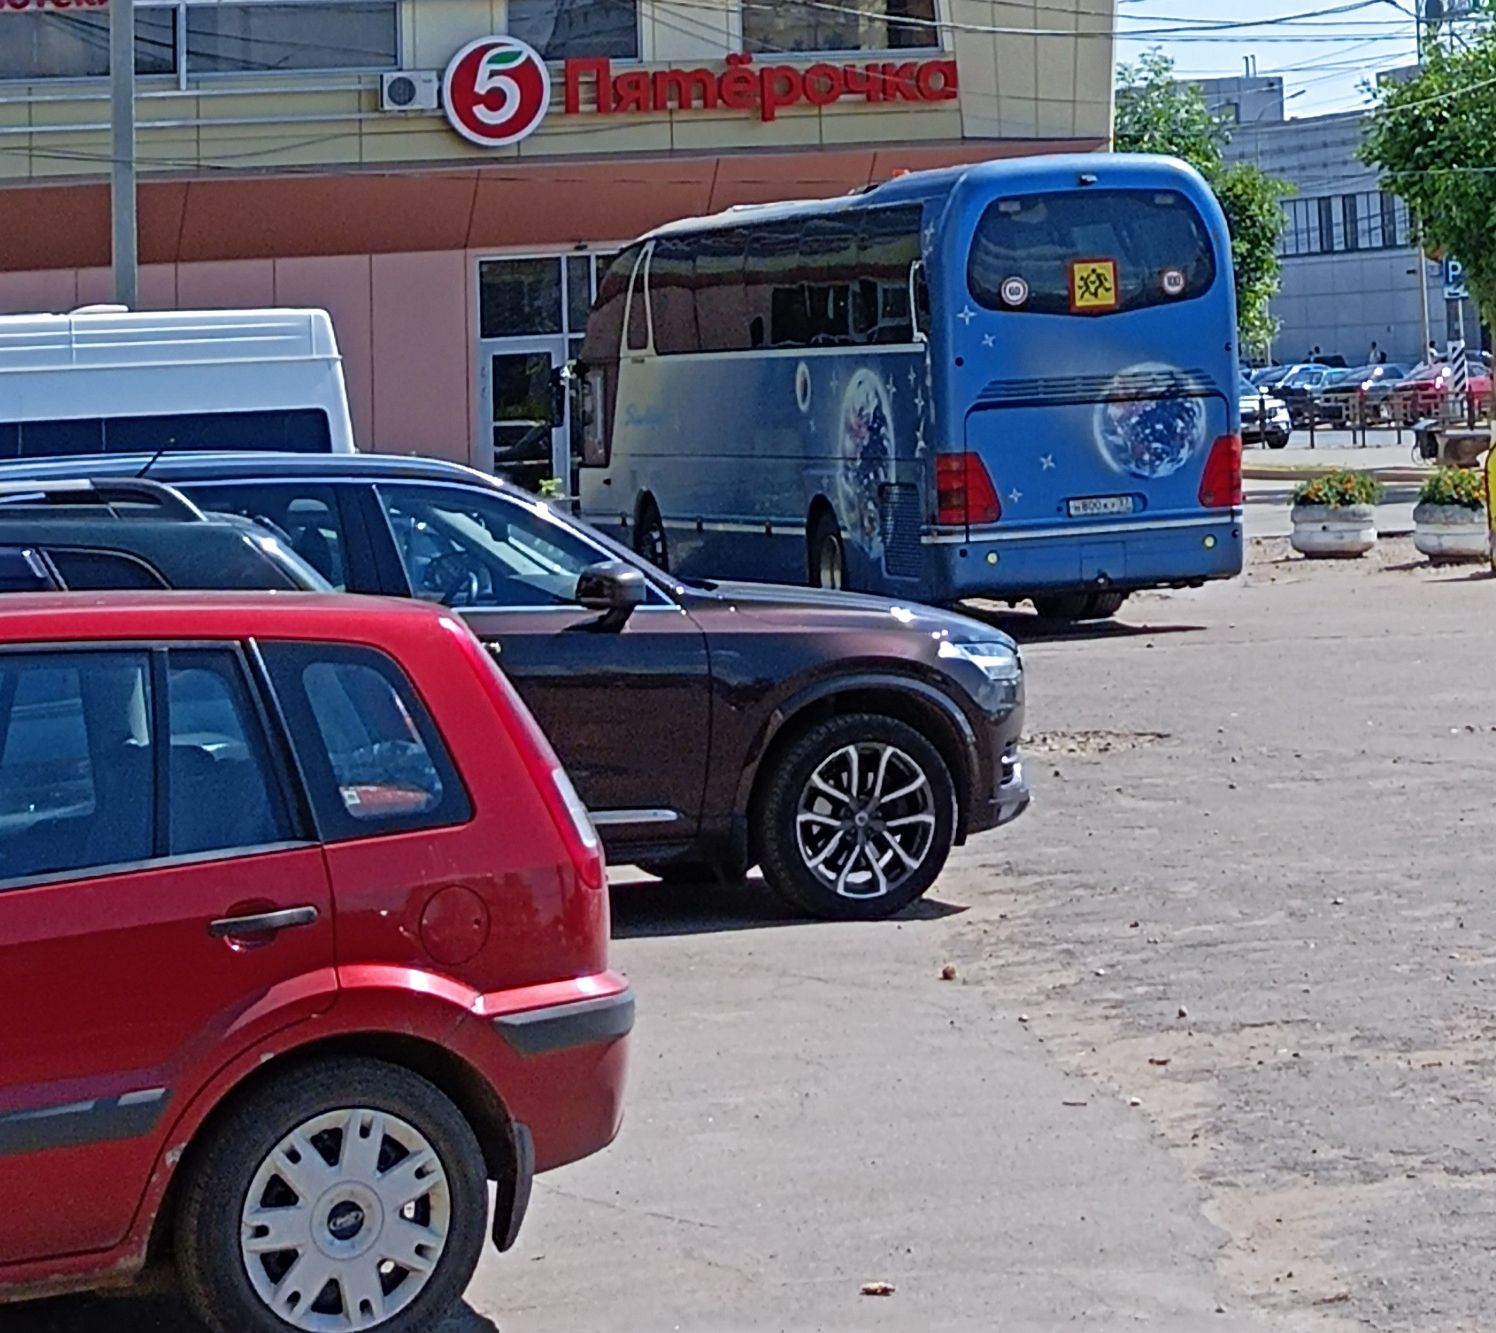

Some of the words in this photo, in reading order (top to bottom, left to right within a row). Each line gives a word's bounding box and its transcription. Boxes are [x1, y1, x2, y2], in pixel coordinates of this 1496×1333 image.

[472, 48, 525, 126] 5
[564, 52, 958, 123] Пятёрочка
[1448, 260, 1463, 283] P
